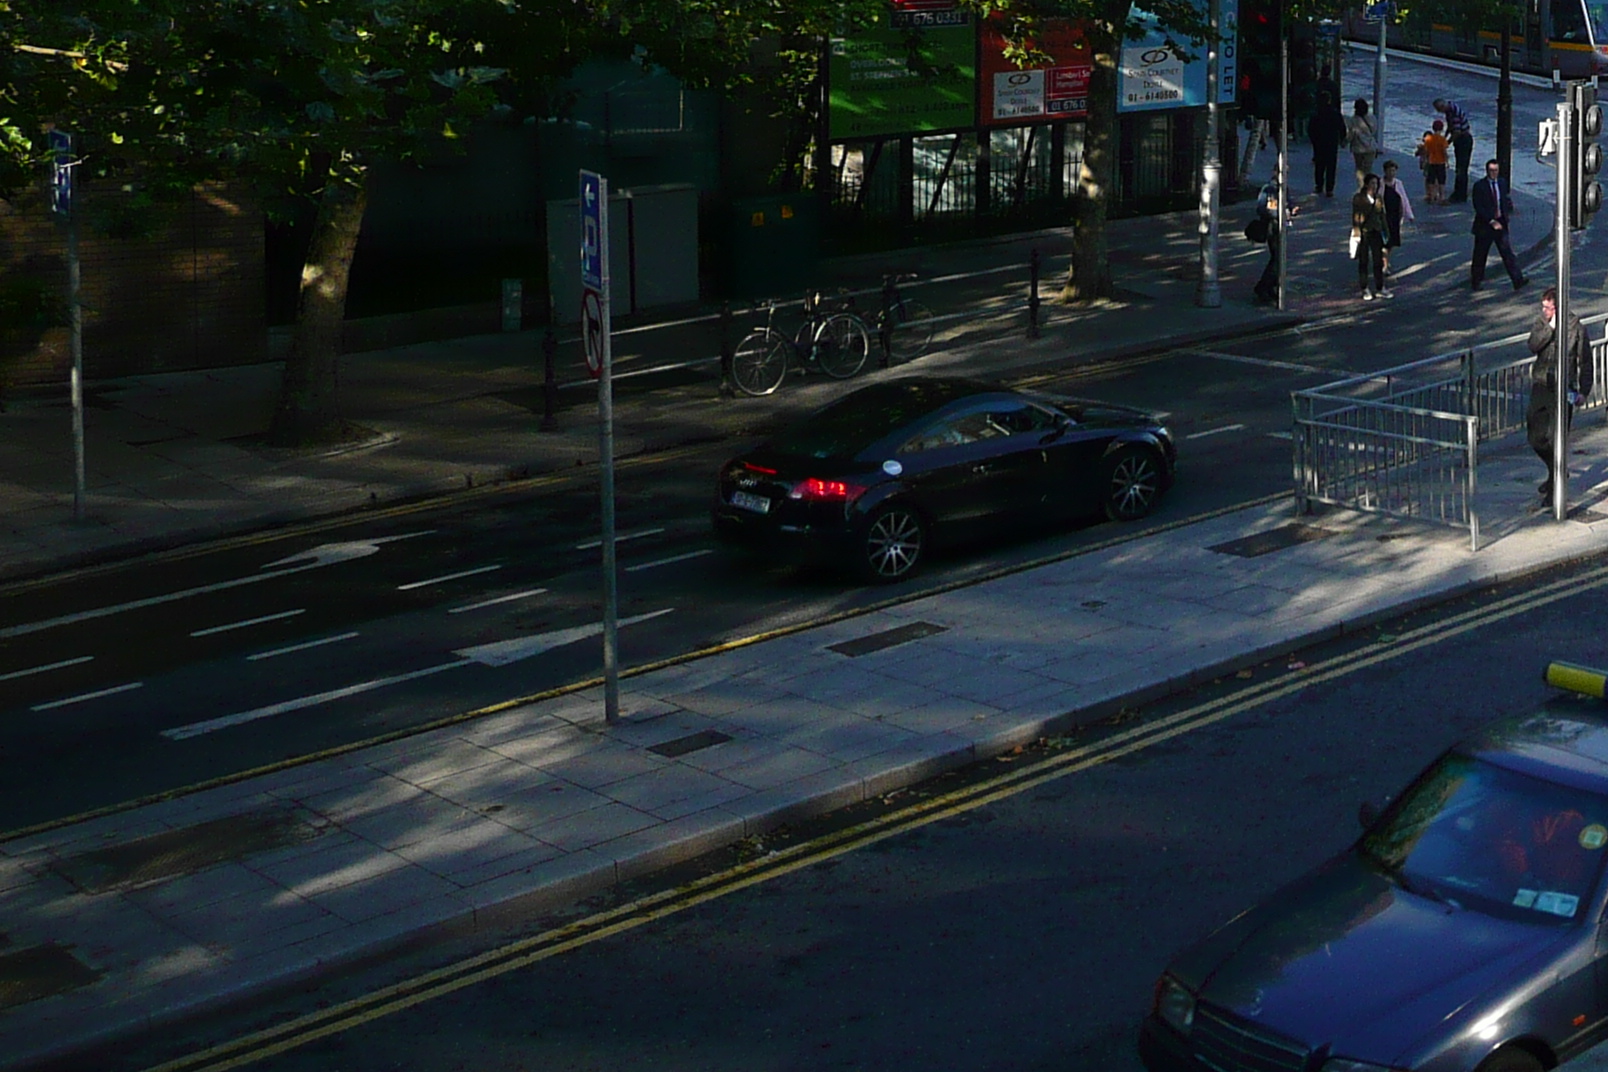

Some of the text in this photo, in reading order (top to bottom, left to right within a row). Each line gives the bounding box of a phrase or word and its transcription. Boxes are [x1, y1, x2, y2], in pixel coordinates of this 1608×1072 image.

[913, 12, 934, 25] 676
[936, 11, 963, 24] 0331
[1223, 34, 1235, 96] TO LET
[1051, 101, 1061, 111] 01
[1063, 99, 1079, 110] 676
[584, 215, 598, 271] P
